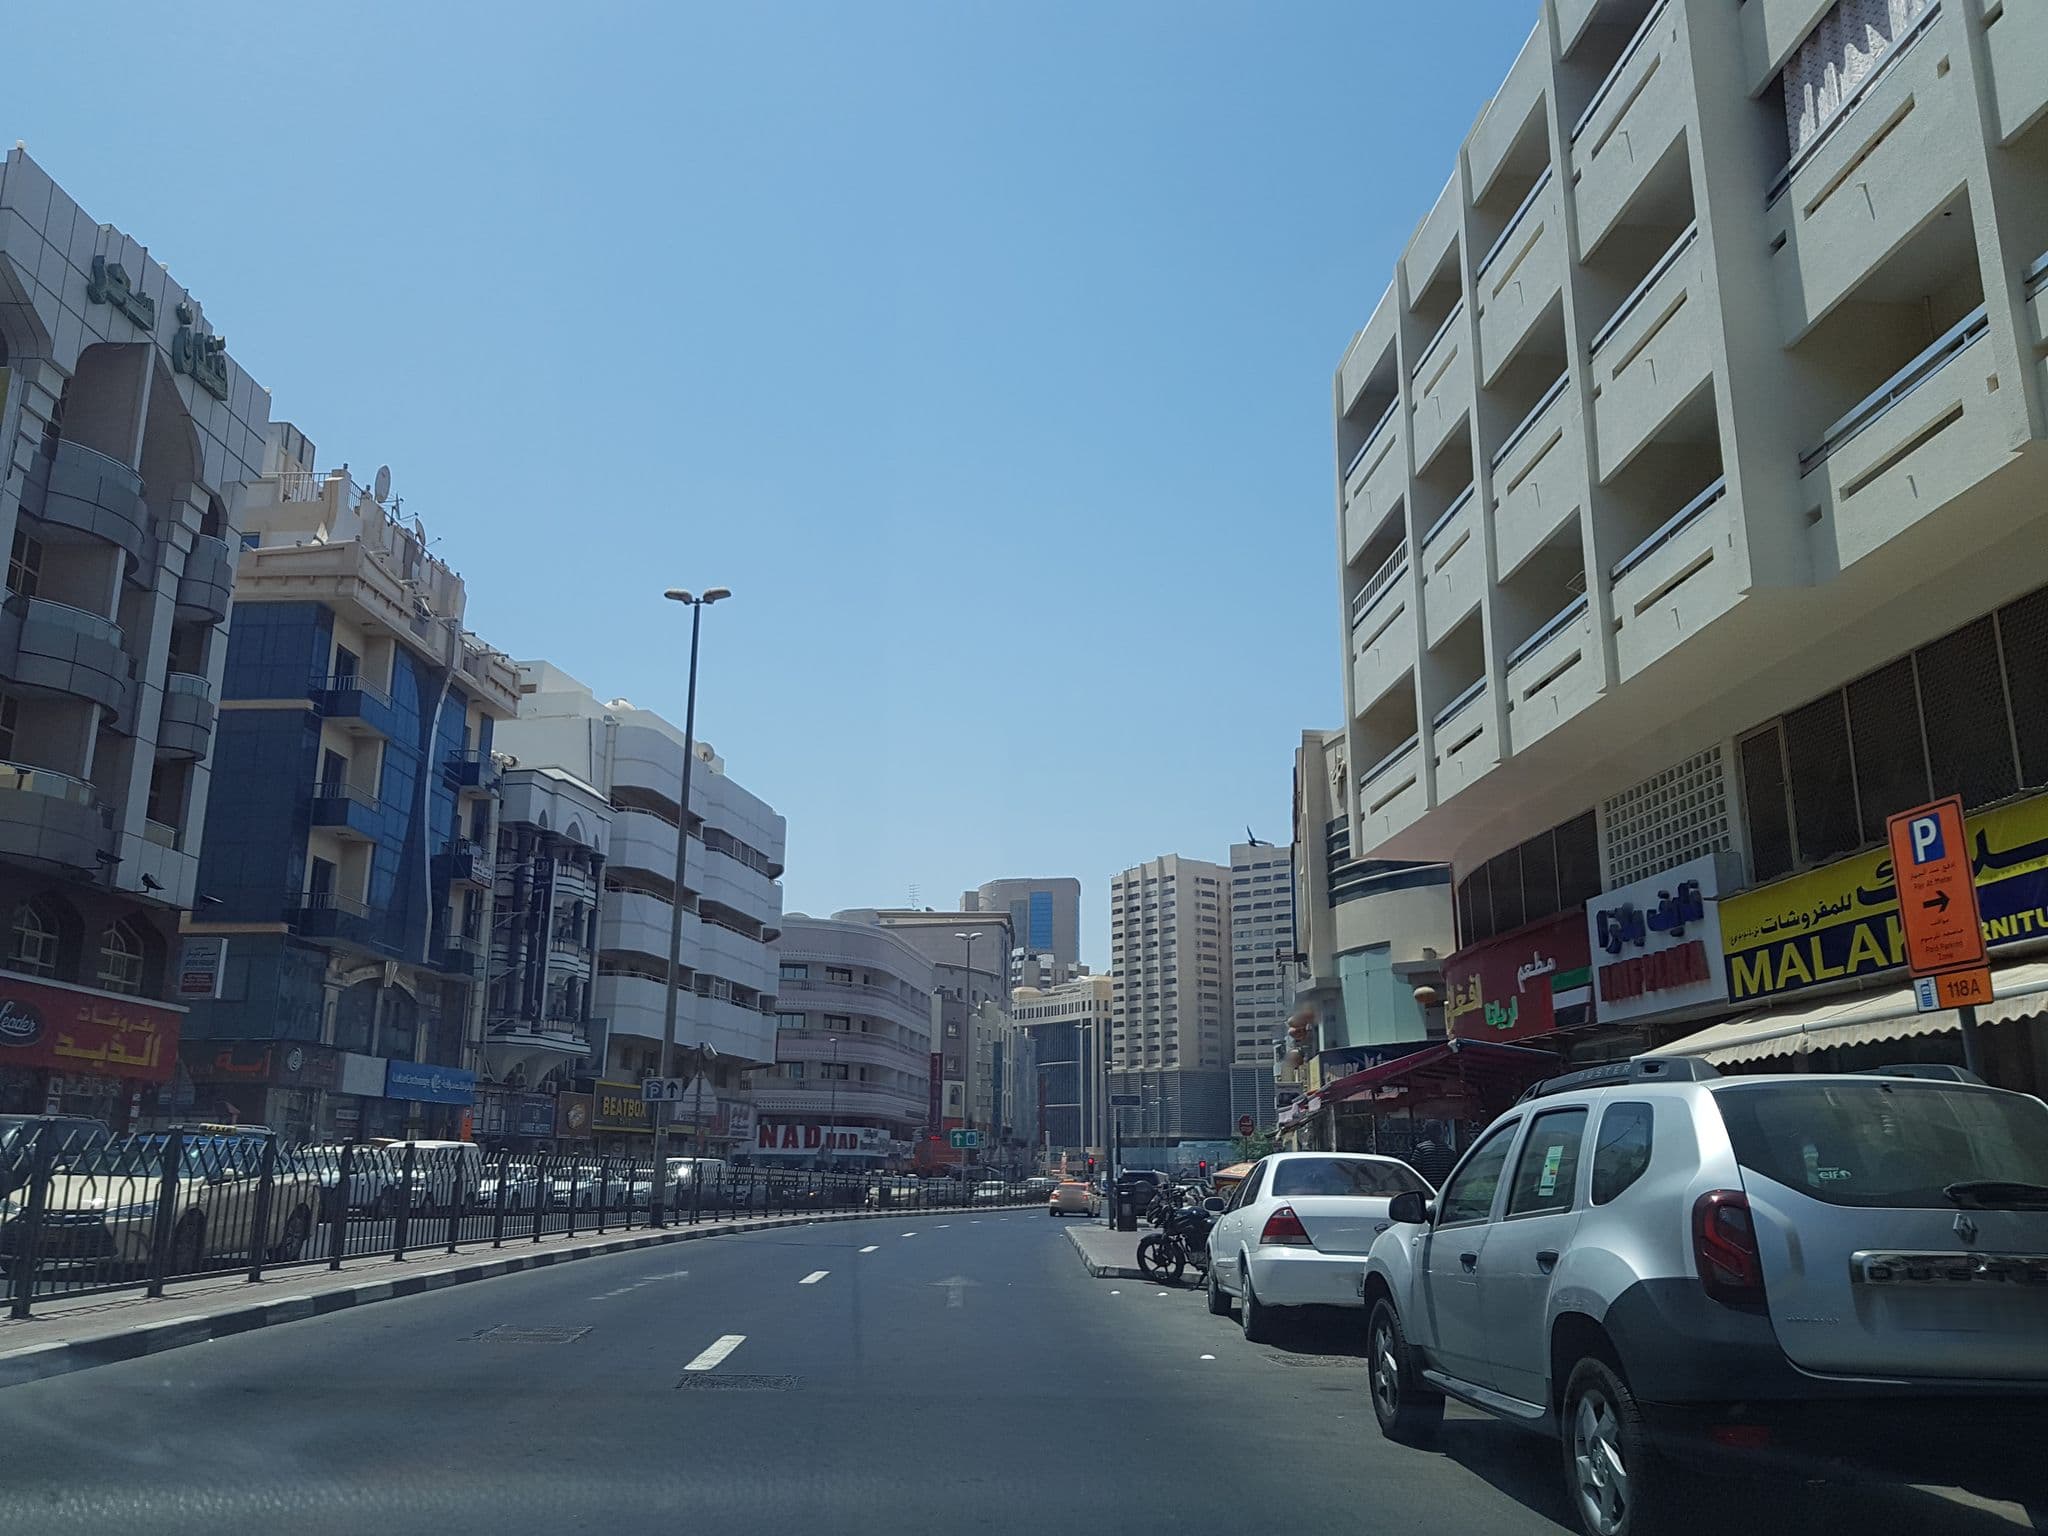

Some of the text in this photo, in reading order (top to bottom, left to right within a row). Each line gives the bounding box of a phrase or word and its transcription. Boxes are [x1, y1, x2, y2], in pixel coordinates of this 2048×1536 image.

[1913, 818, 1937, 862] P
[1760, 893, 1852, 935] للمفروشات
[1517, 951, 1556, 993] مطعم
[0, 1001, 37, 1036] Leader
[1578, 1064, 1631, 1081] DUSTER
[602, 1096, 647, 1118] BEATBOX
[759, 1124, 822, 1150] NAD
[826, 1132, 858, 1150] NAD
